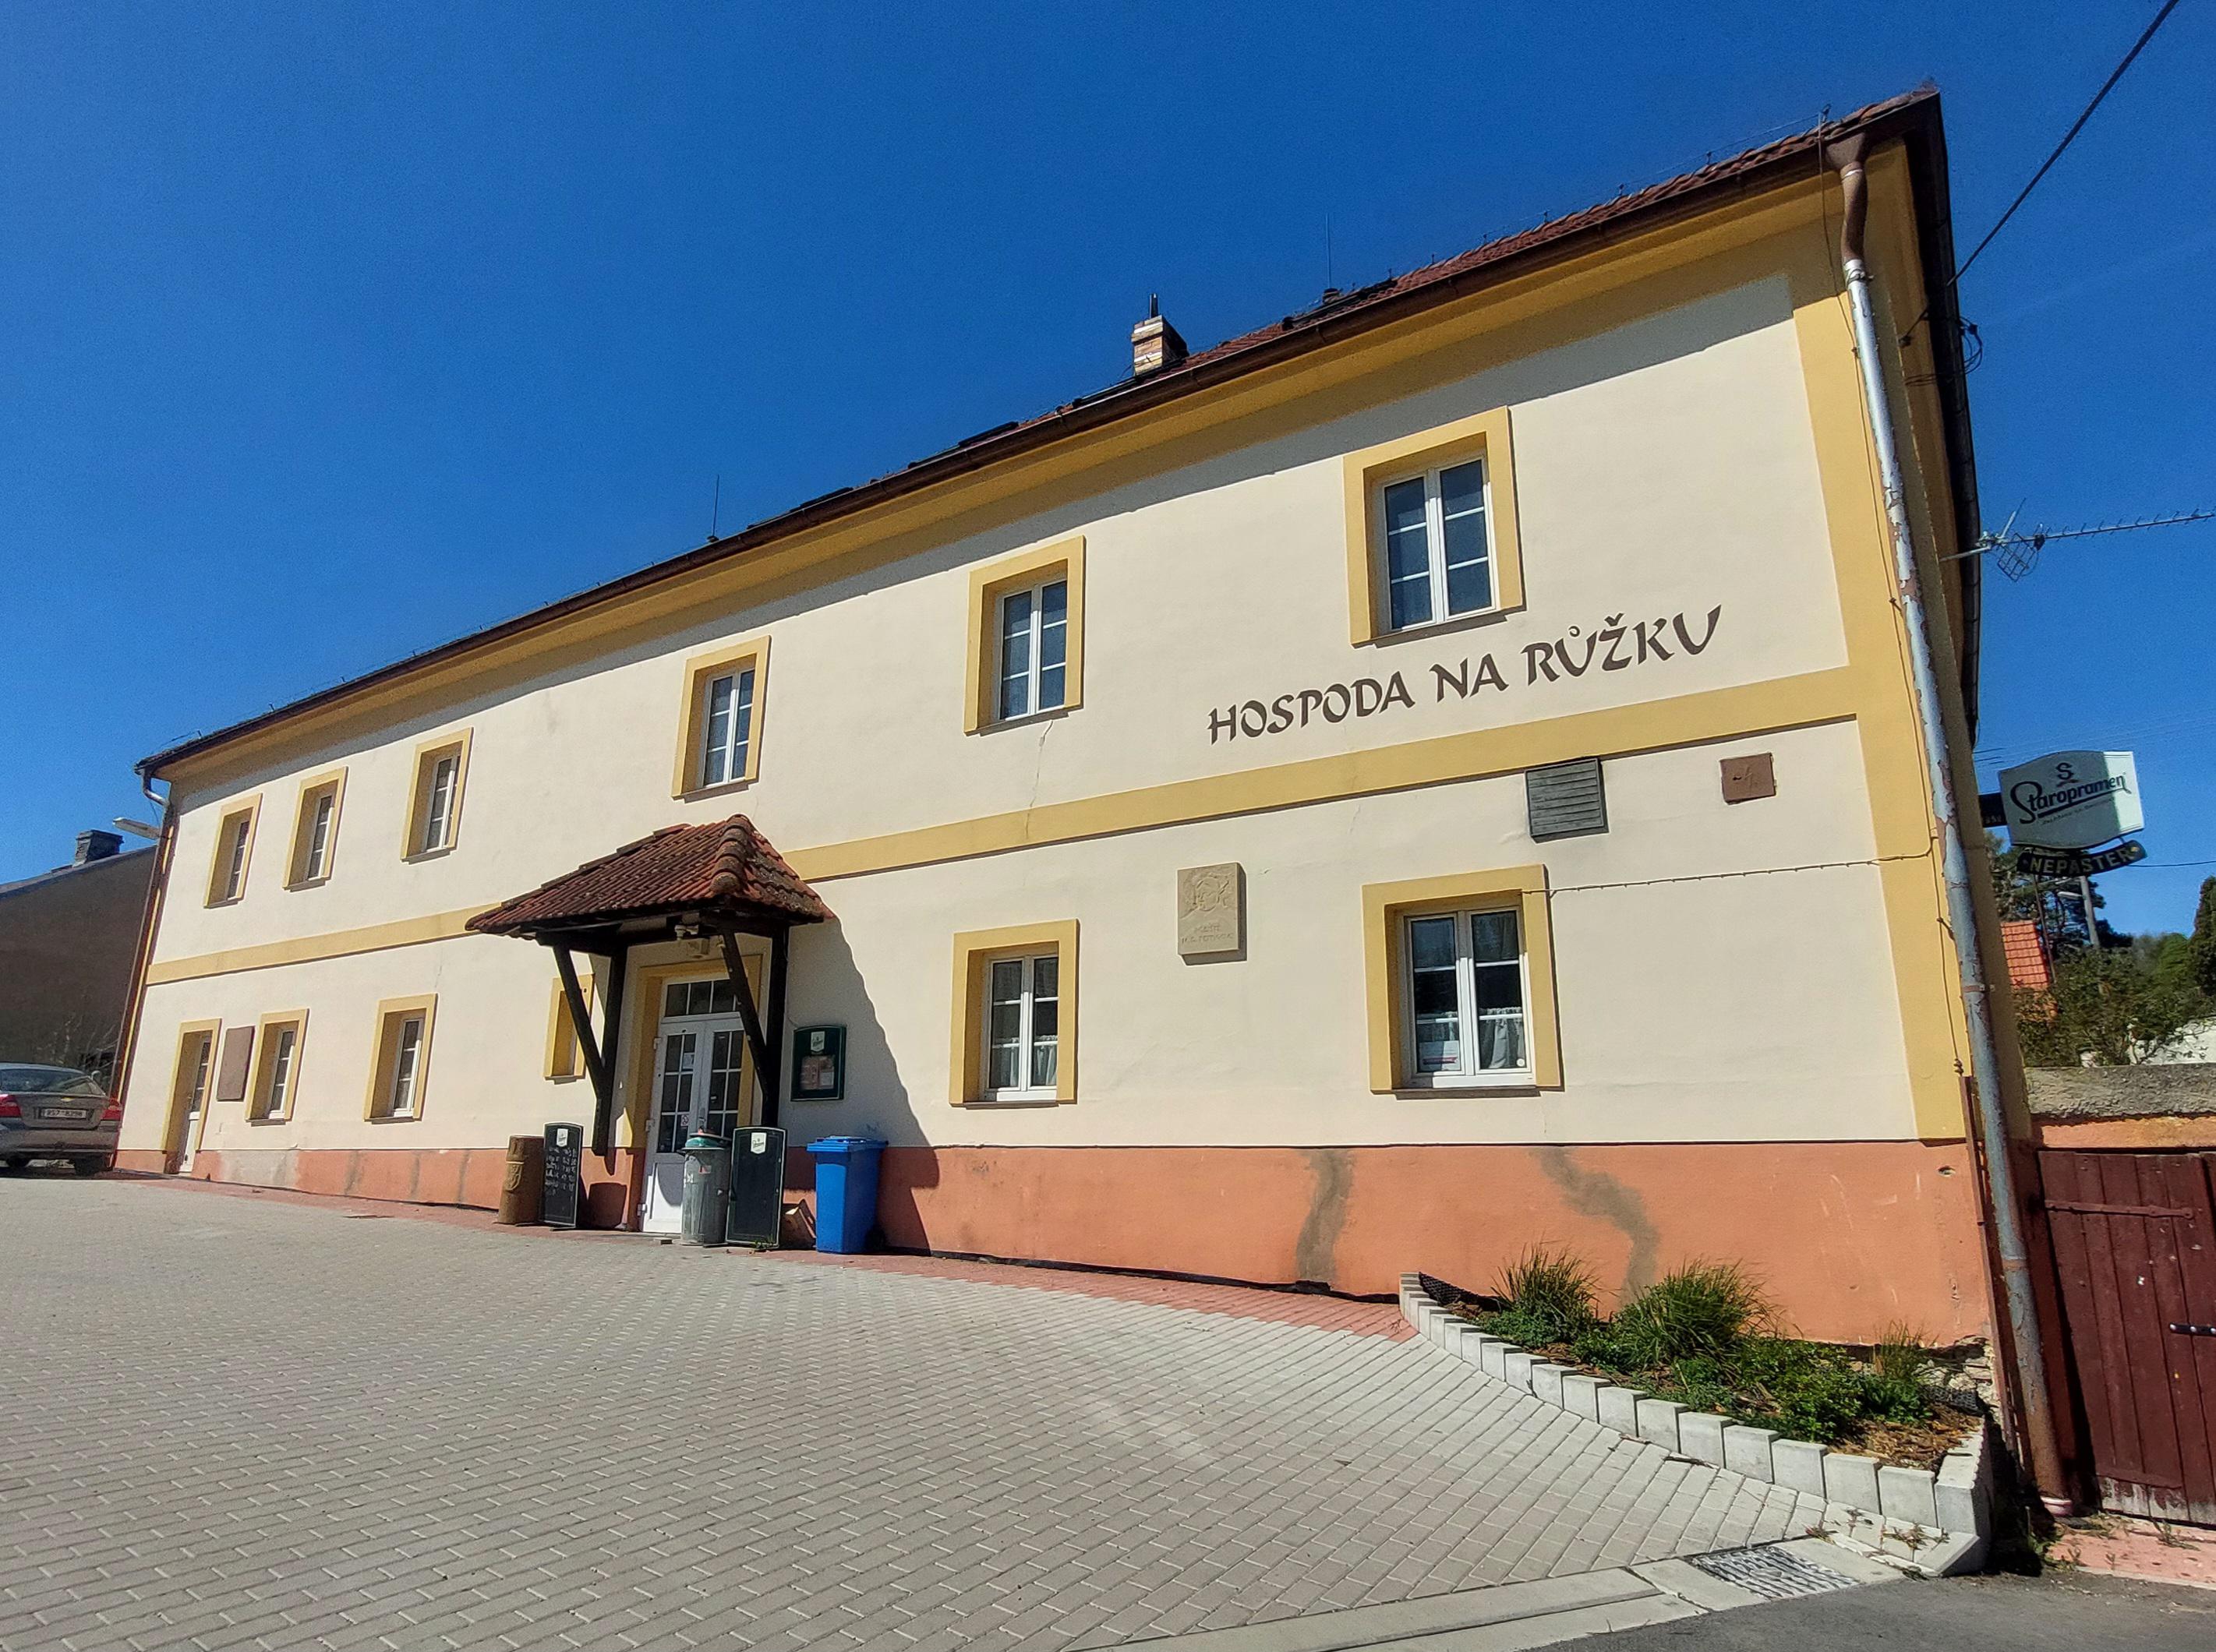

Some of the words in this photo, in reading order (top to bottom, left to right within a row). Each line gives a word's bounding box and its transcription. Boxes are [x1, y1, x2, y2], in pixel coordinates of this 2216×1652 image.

[1207, 670, 1415, 746] HOSPODA
[1429, 653, 1509, 703] NA
[1521, 604, 1723, 687] RŮŽKU
[2009, 775, 2132, 824] Staropramen
